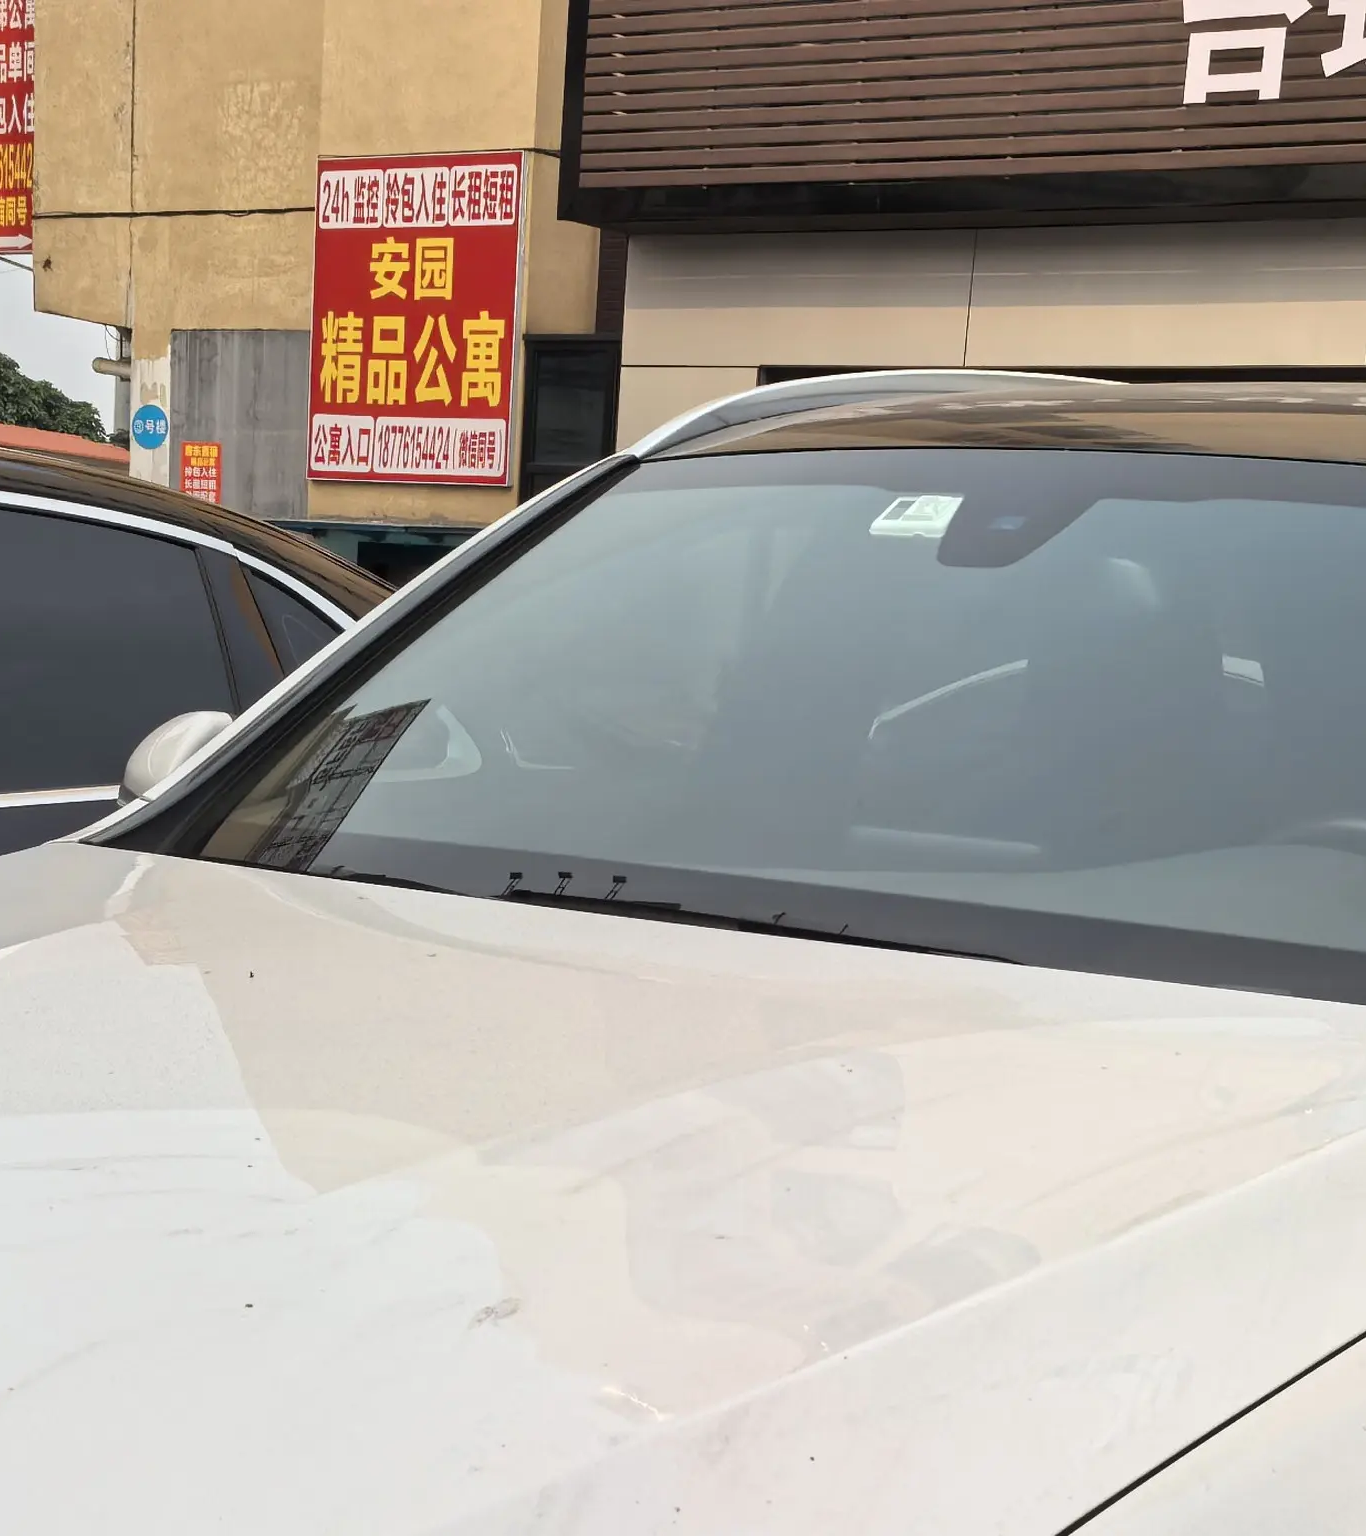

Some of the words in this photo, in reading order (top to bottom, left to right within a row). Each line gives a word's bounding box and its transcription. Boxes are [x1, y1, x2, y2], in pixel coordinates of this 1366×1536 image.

[385, 172, 447, 224] 拎包入住
[451, 168, 515, 222] 长租短租
[369, 236, 454, 301] 安园
[320, 310, 506, 407] 精品公寓
[314, 423, 372, 467] 公寓入口
[377, 425, 451, 470] 18776154424
